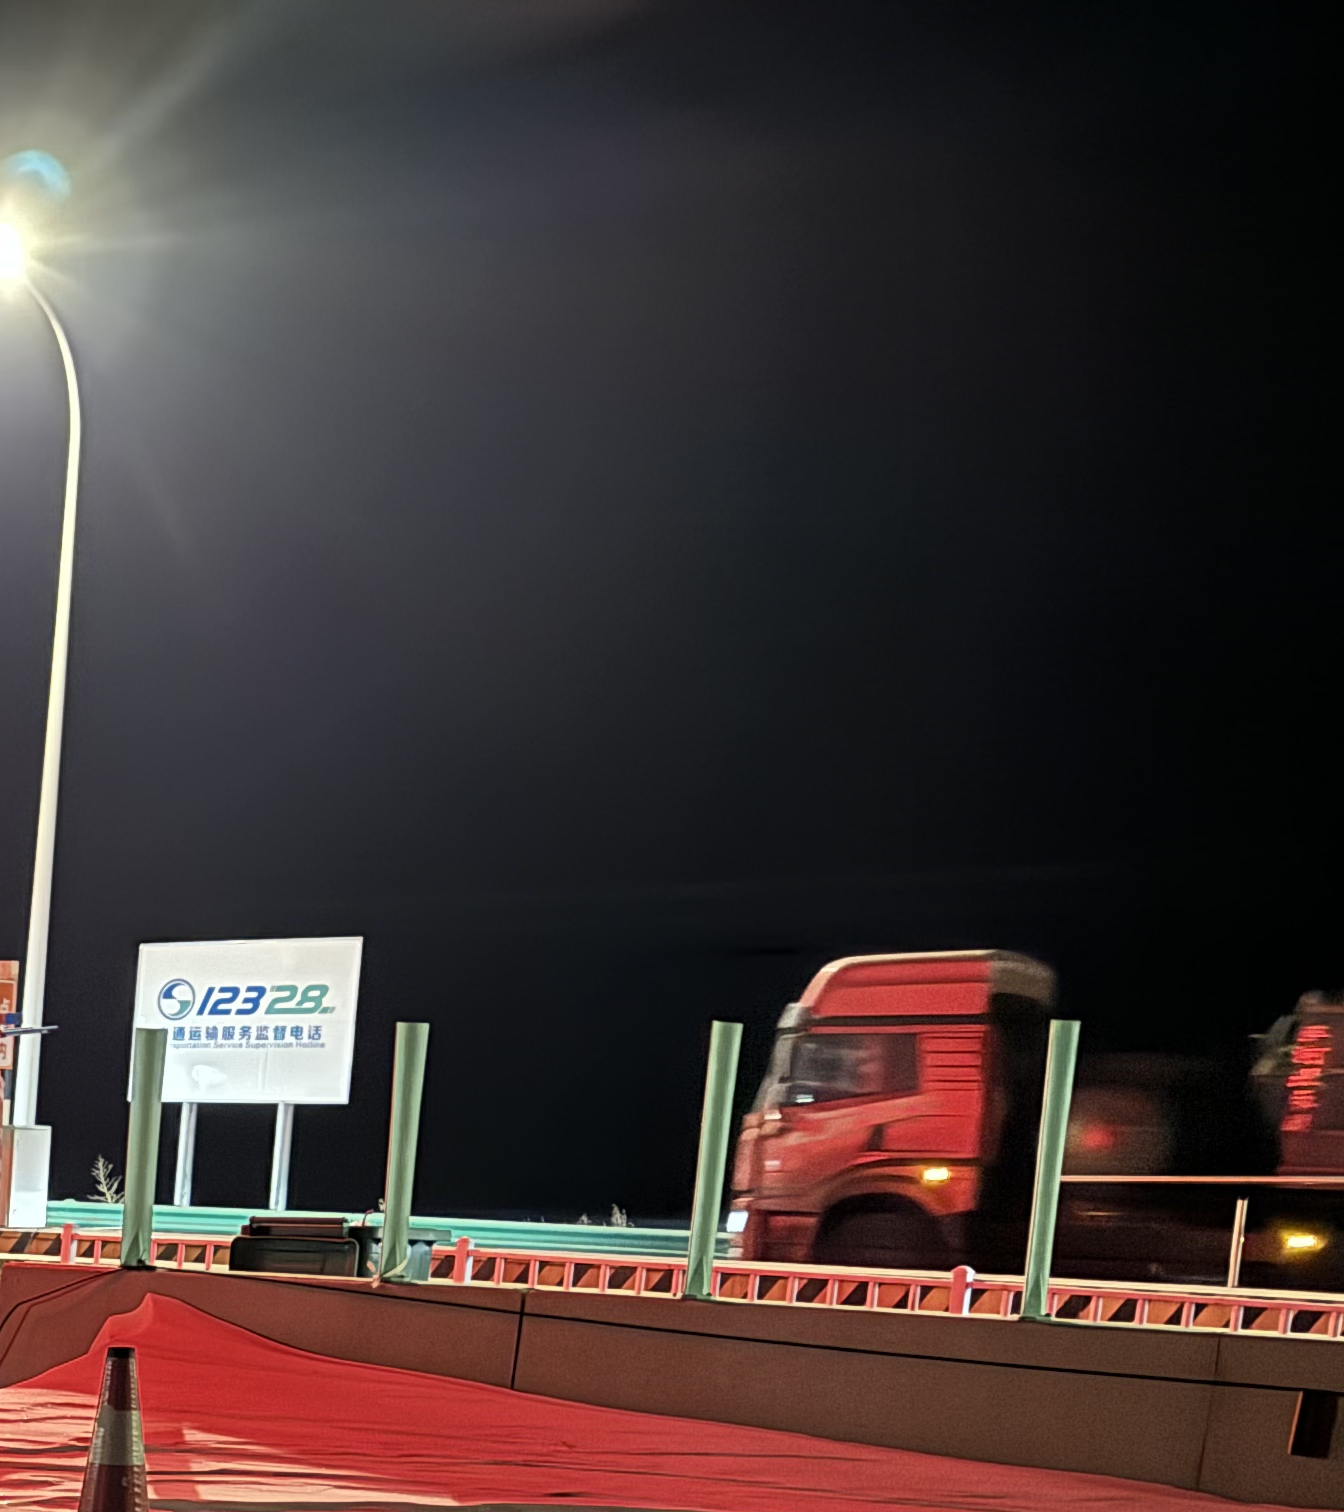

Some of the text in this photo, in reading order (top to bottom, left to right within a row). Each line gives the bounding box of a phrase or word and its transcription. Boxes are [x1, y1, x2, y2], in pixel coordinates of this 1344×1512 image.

[196, 984, 333, 1016] 12328
[172, 1025, 323, 1041] 通运输服务监督电话
